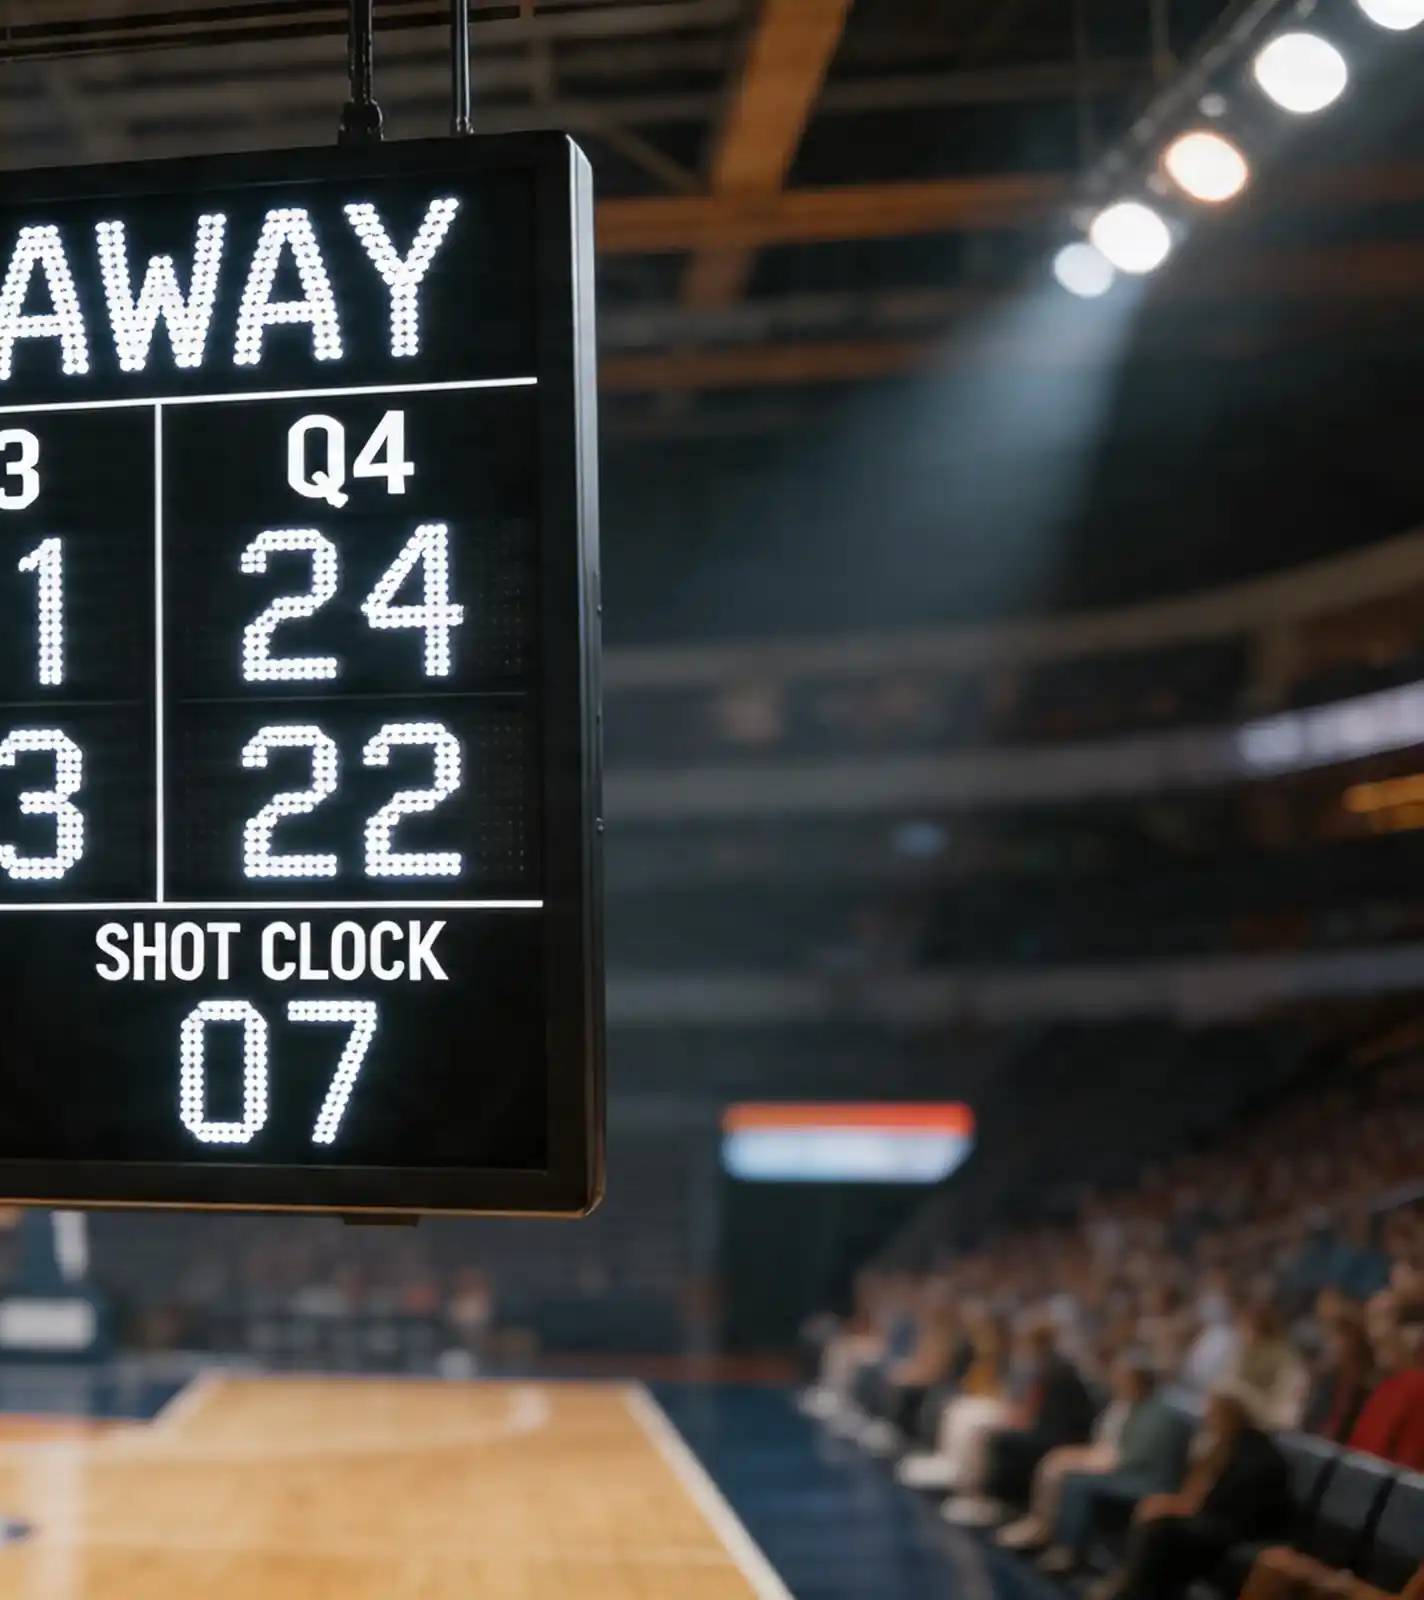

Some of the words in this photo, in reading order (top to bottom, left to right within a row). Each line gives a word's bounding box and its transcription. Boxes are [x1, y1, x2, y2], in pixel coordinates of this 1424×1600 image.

[288, 412, 415, 508] Q4
[242, 523, 464, 681] 24
[242, 722, 461, 878] 22
[96, 922, 241, 980] SHOT
[262, 920, 449, 980] CLOCK
[180, 1000, 377, 1144] 07
